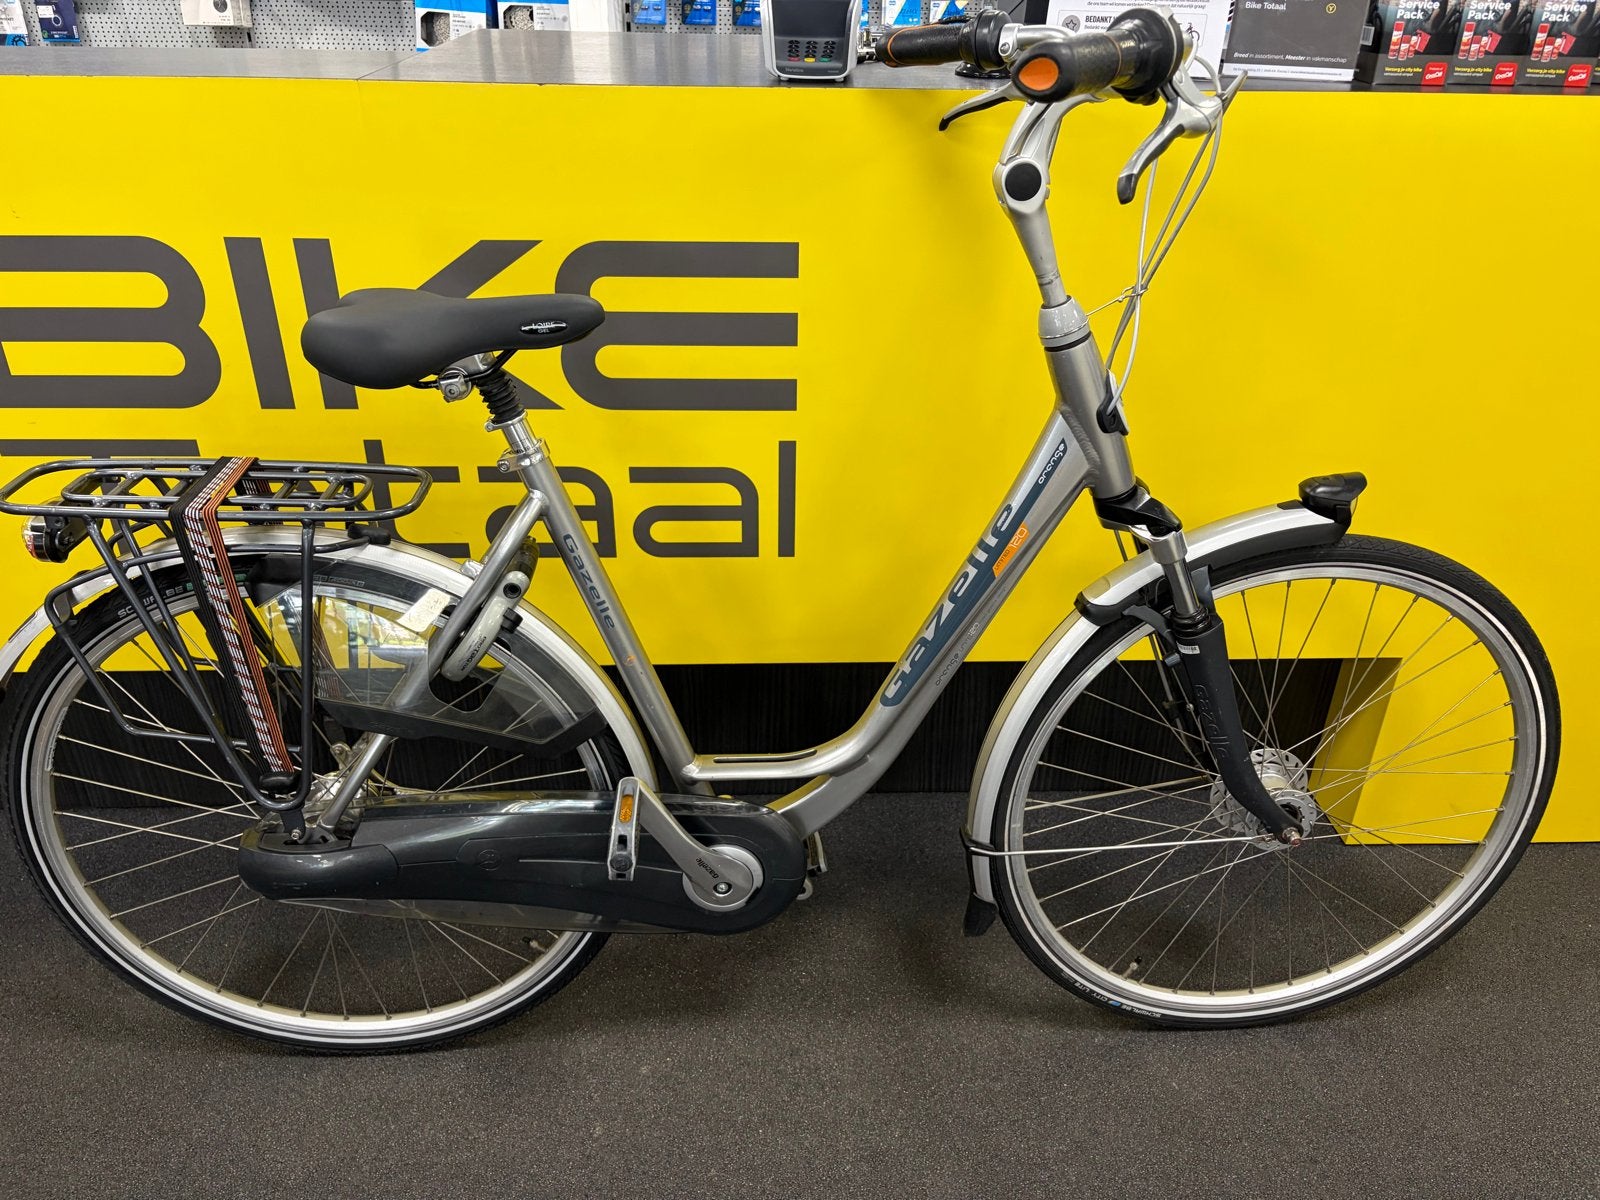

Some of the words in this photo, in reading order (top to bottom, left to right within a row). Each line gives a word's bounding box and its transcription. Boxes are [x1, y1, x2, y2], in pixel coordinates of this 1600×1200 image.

[1245, 1, 1262, 9] Bike
[1263, 2, 1287, 10] Totaal
[1399, 0, 1440, 9] Service
[1469, 0, 1511, 10] Service
[1544, 1, 1587, 12] Service
[1085, 15, 1112, 23] BEDANKT
[1396, 9, 1424, 19] Pack
[1467, 10, 1495, 20] Pack
[1541, 11, 1570, 21] Pack
[0, 235, 800, 411] BIKE
[1038, 442, 1065, 484] orange
[0, 439, 796, 559] Ttaal
[1009, 526, 1028, 549] 120
[562, 533, 615, 629] Gazelle
[880, 503, 1014, 706] Gazelle
[935, 652, 960, 686] orange
[1194, 683, 1230, 759] Gazelle
[695, 857, 720, 879] Gazelle
[1073, 981, 1090, 994] LITE
[1090, 991, 1109, 1003] CITY
[1120, 1003, 1162, 1019] SCHWALBE
